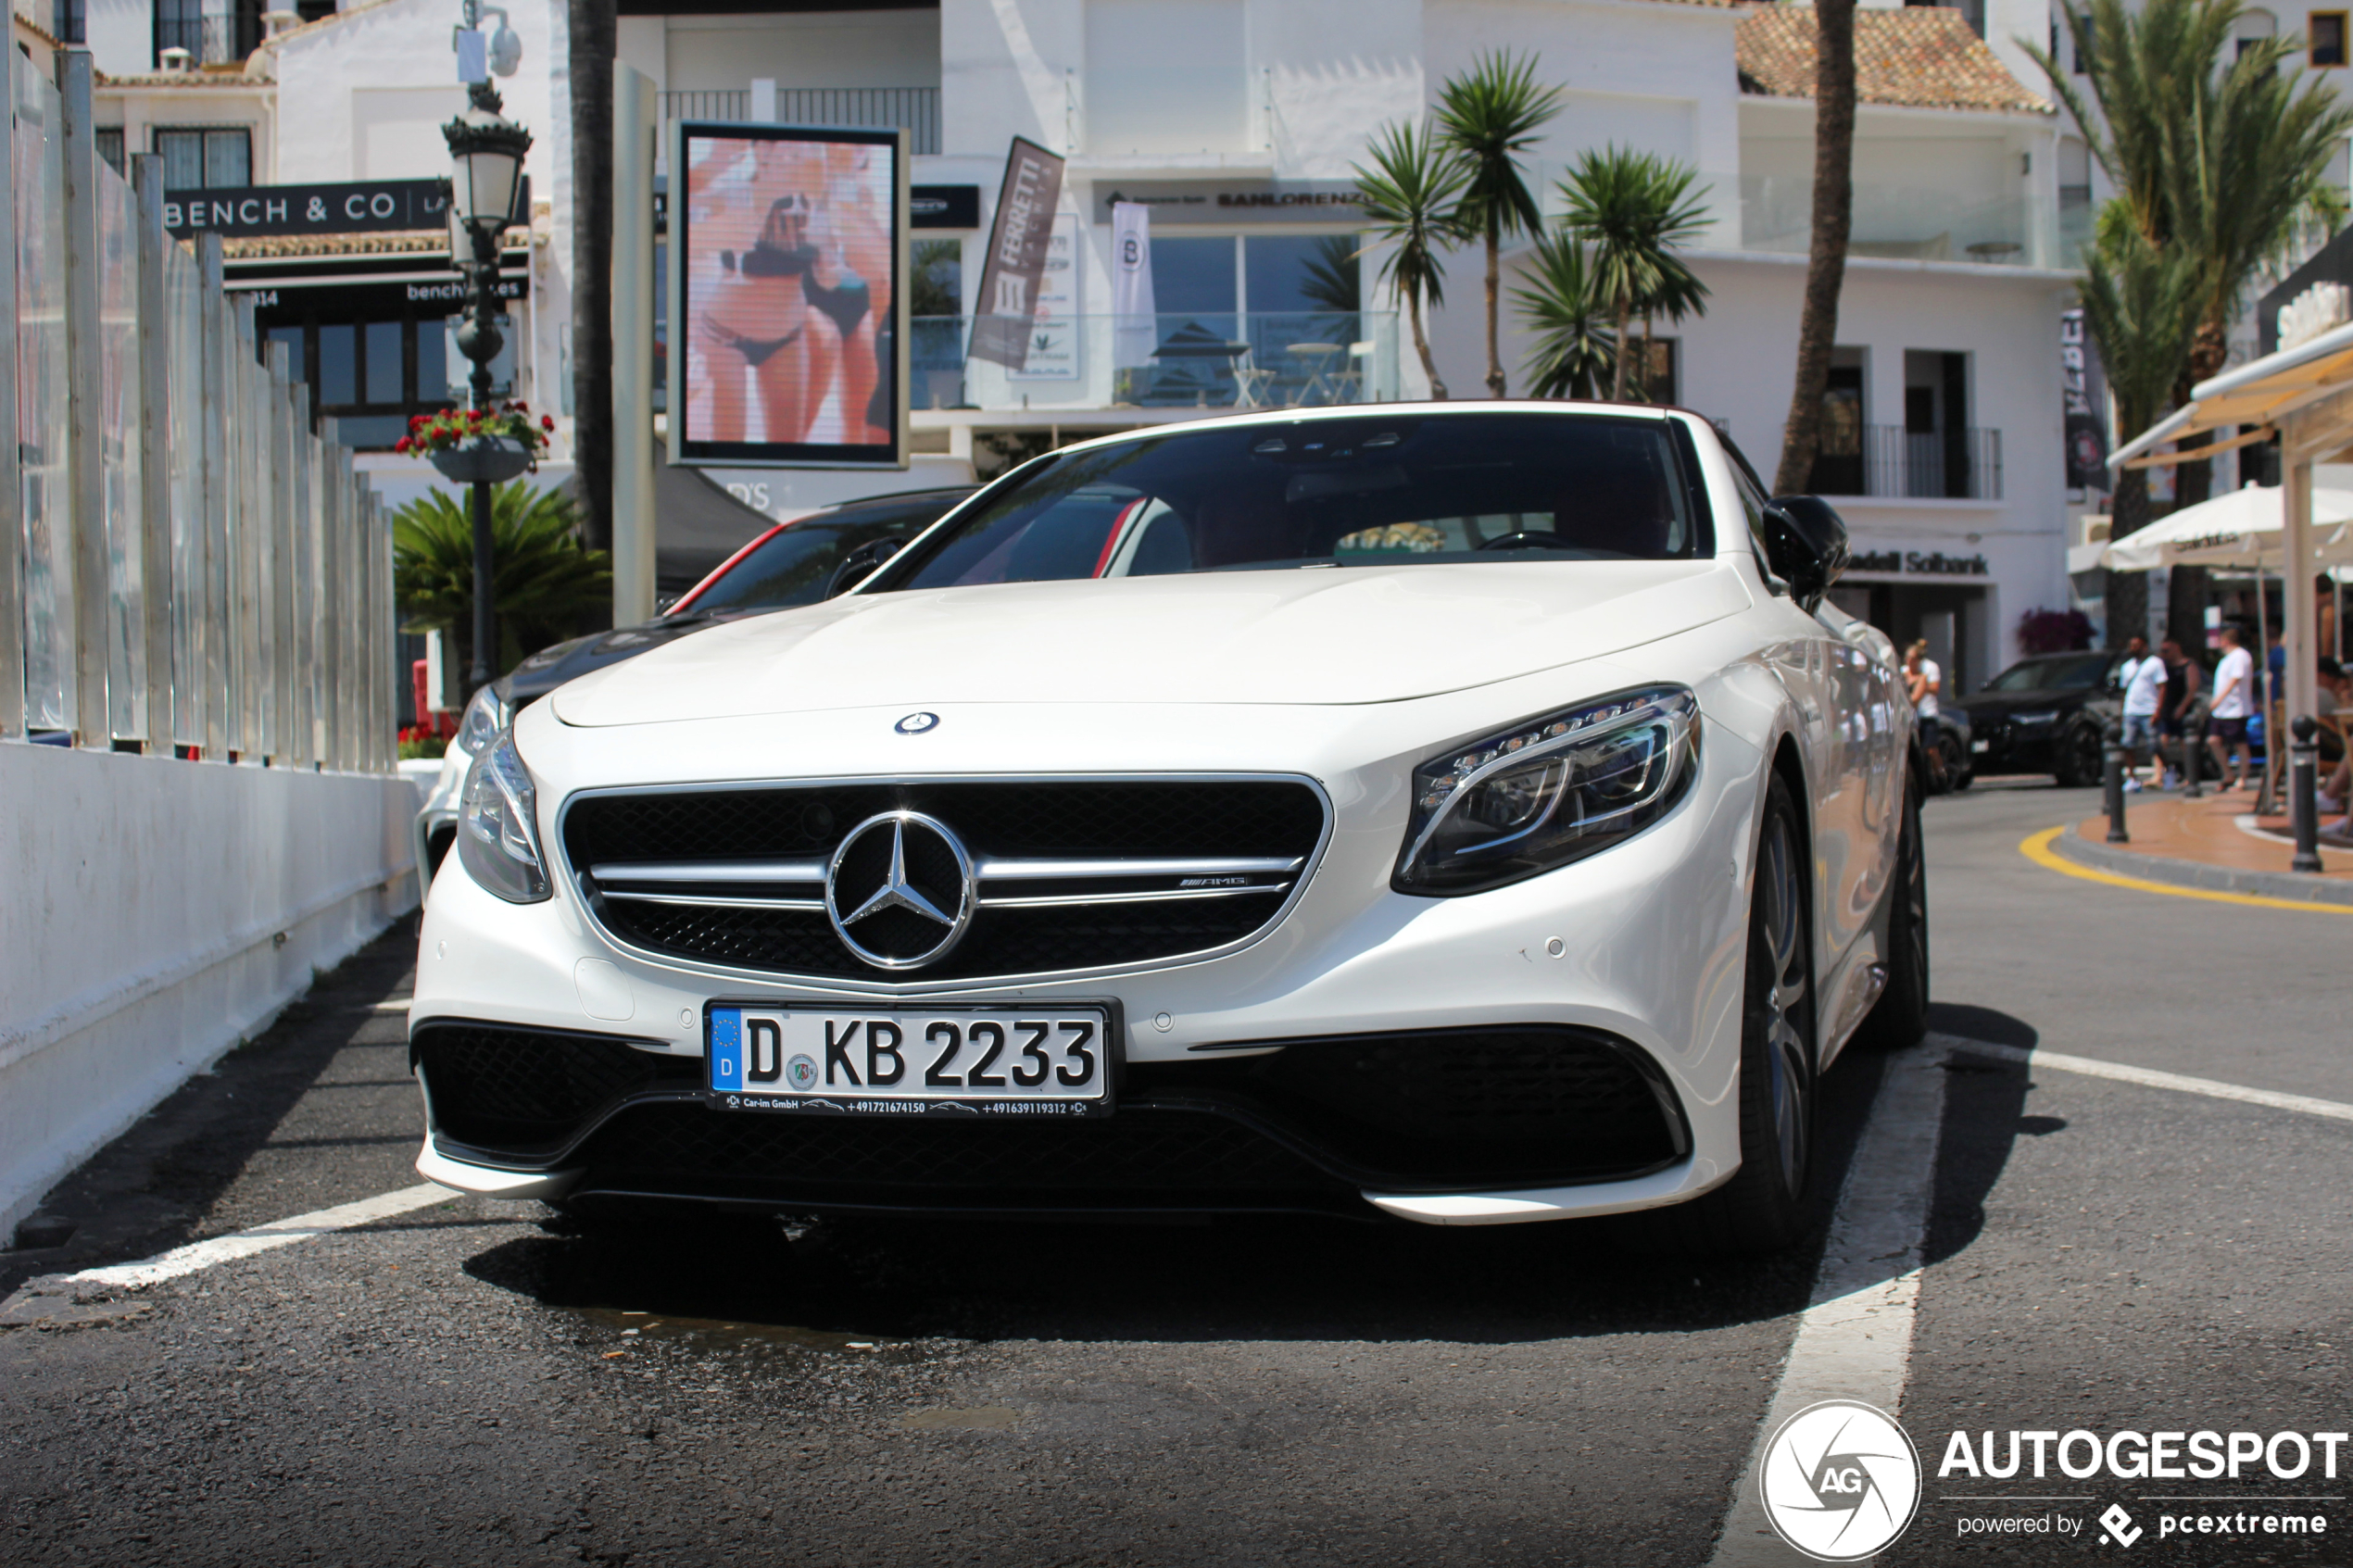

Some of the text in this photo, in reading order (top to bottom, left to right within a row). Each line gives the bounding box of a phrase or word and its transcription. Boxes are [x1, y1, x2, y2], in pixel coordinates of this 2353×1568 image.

[166, 193, 395, 228] BENCH & CO
[999, 157, 1041, 267] FERRETTI
[1906, 550, 1989, 576] Solbank
[1201, 876, 1245, 885] AMG
[747, 1018, 782, 1083] D
[824, 1020, 905, 1086] KB
[925, 1021, 1095, 1087] 2233
[721, 1058, 733, 1076] D
[743, 1098, 771, 1109] Car-im
[772, 1099, 799, 1110] GmbH
[847, 1101, 925, 1113] +491721674150
[982, 1102, 1066, 1114] +491639119312
